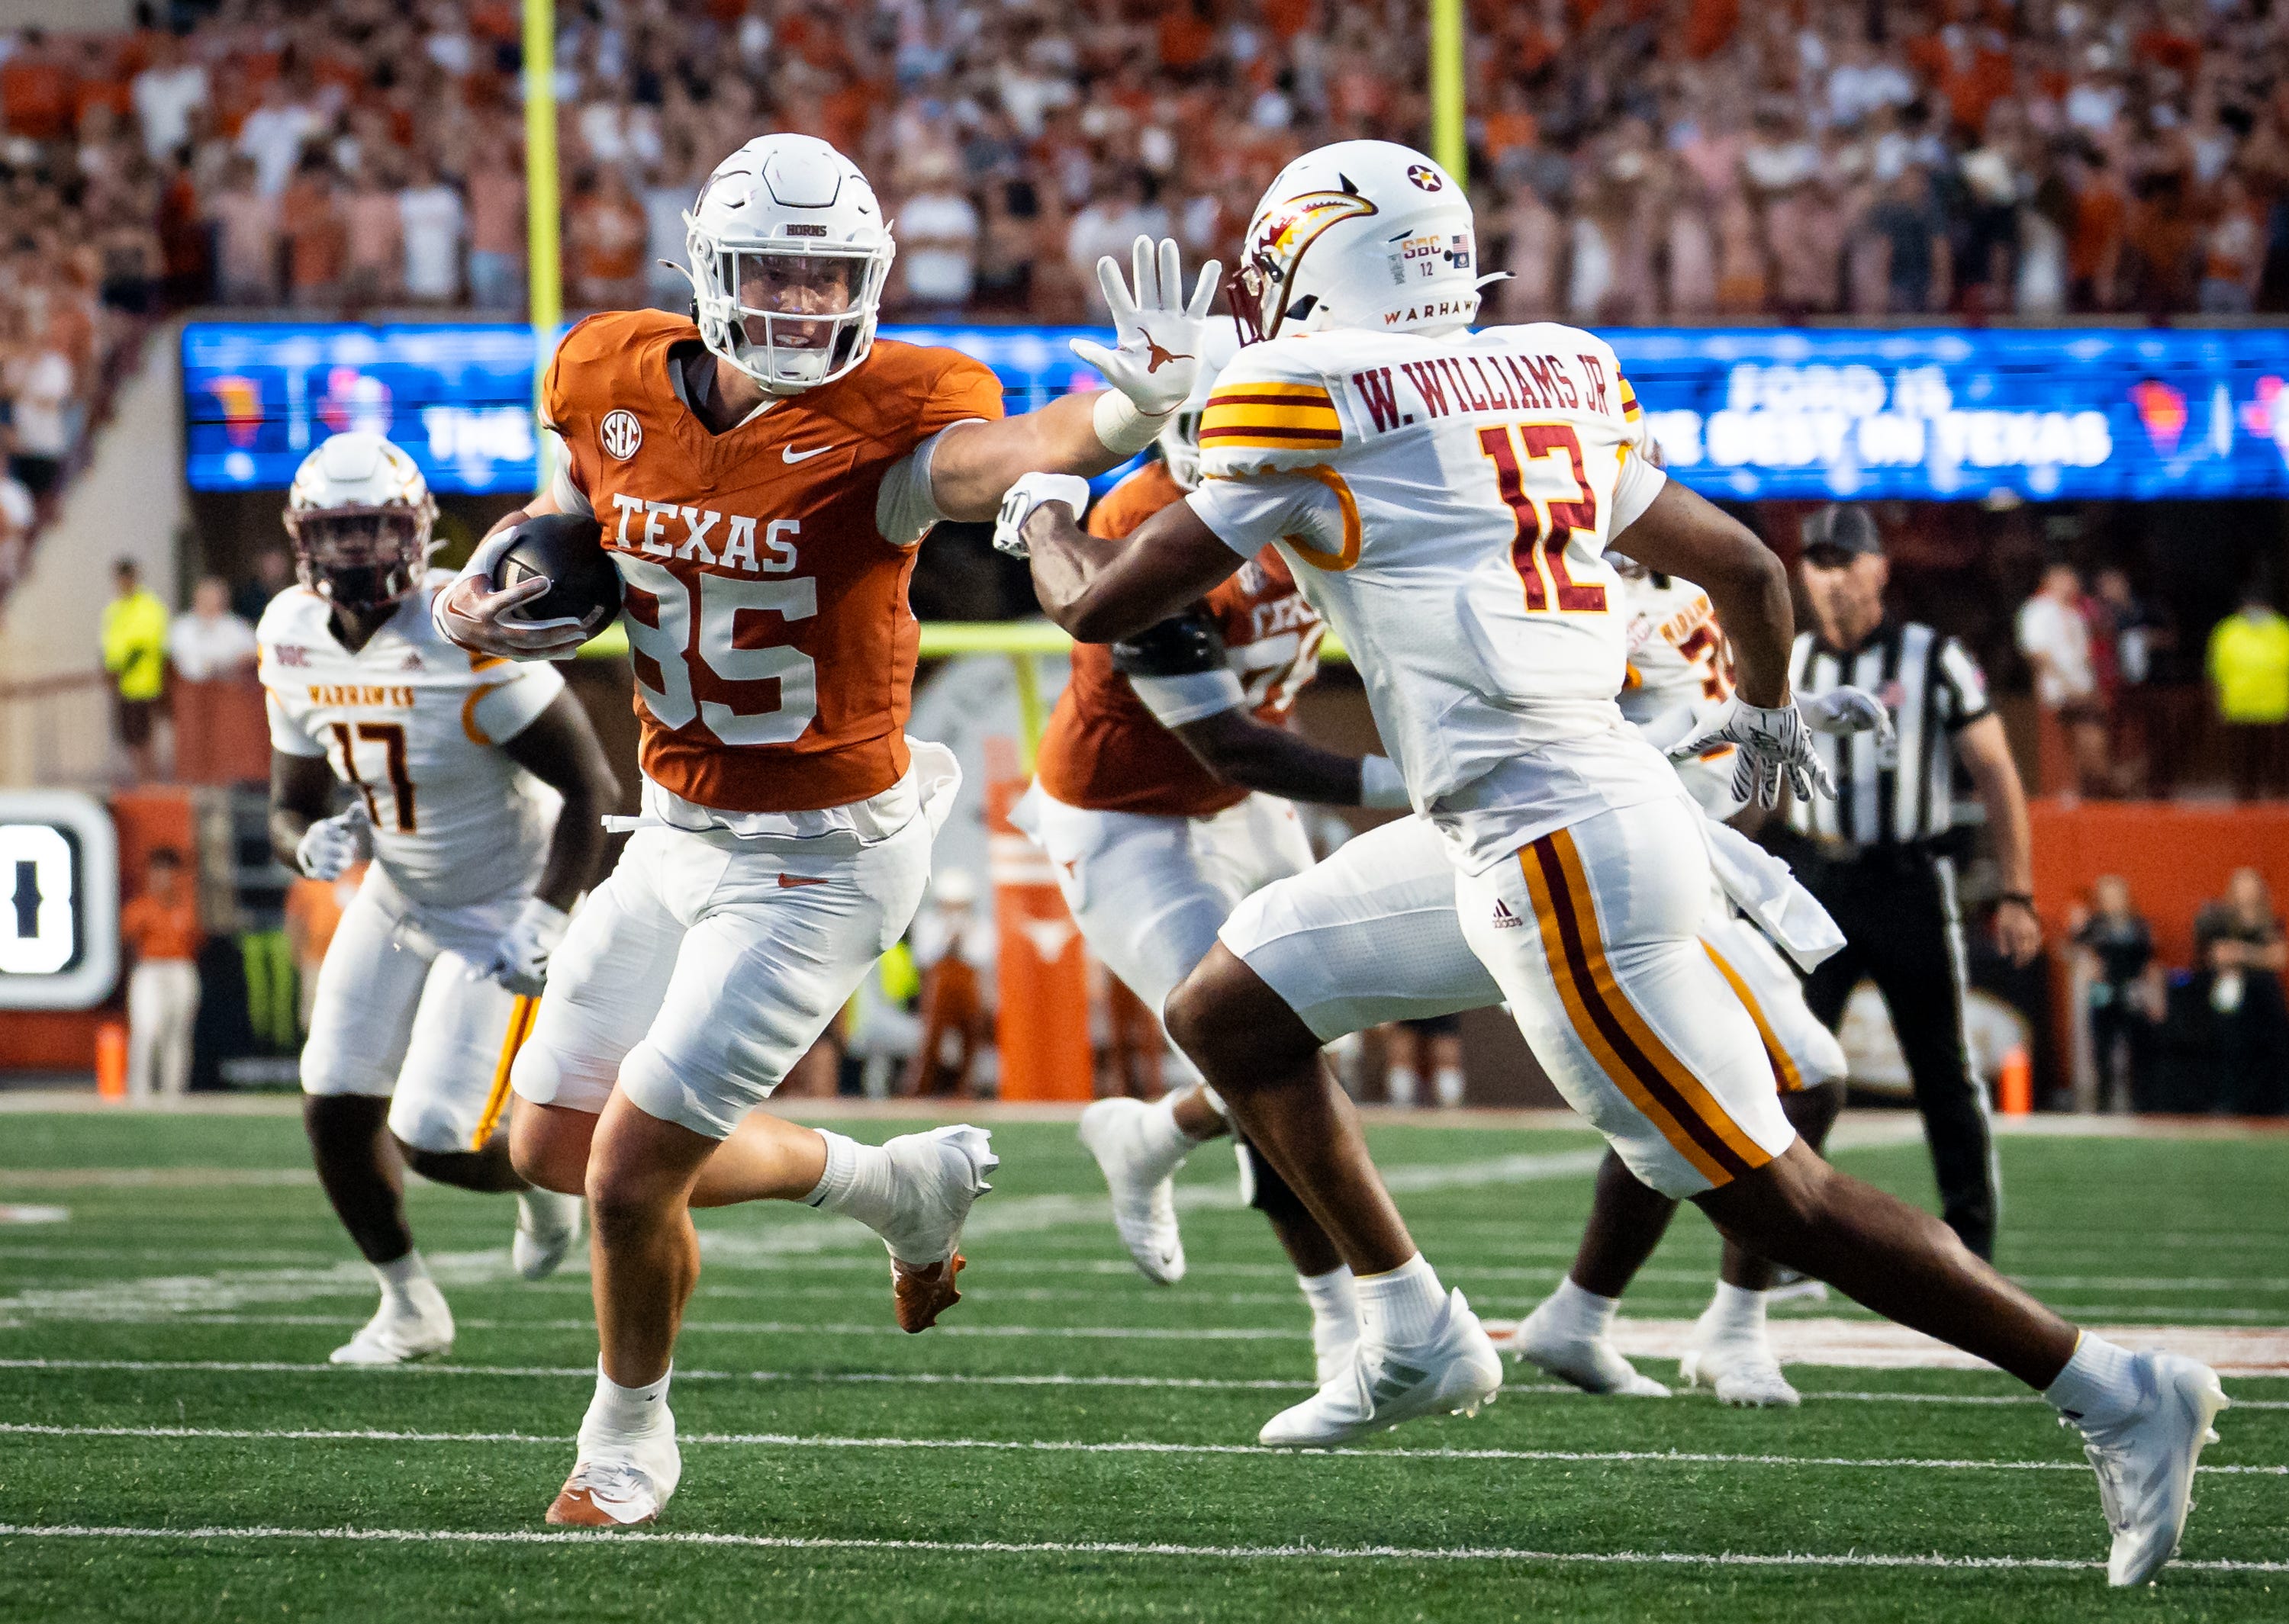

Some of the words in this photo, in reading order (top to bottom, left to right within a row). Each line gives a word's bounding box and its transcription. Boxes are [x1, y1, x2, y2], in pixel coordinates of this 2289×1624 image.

[786, 224, 827, 237] HORNS
[1402, 235, 1441, 259] SBC
[1420, 261, 1433, 277] 12
[1353, 366, 1414, 433] W.
[1401, 355, 1579, 419] WILLIAMS
[1576, 354, 1610, 416] JR
[604, 413, 639, 457] SEC
[1708, 410, 1850, 466] BEST
[1858, 411, 1925, 466] IN
[1933, 410, 2112, 467] TEXAS
[612, 492, 800, 574] TEXAS
[1475, 421, 1608, 615] 12
[607, 550, 818, 745] 85
[307, 683, 416, 708] WARHAWKS
[329, 722, 417, 835] 17
